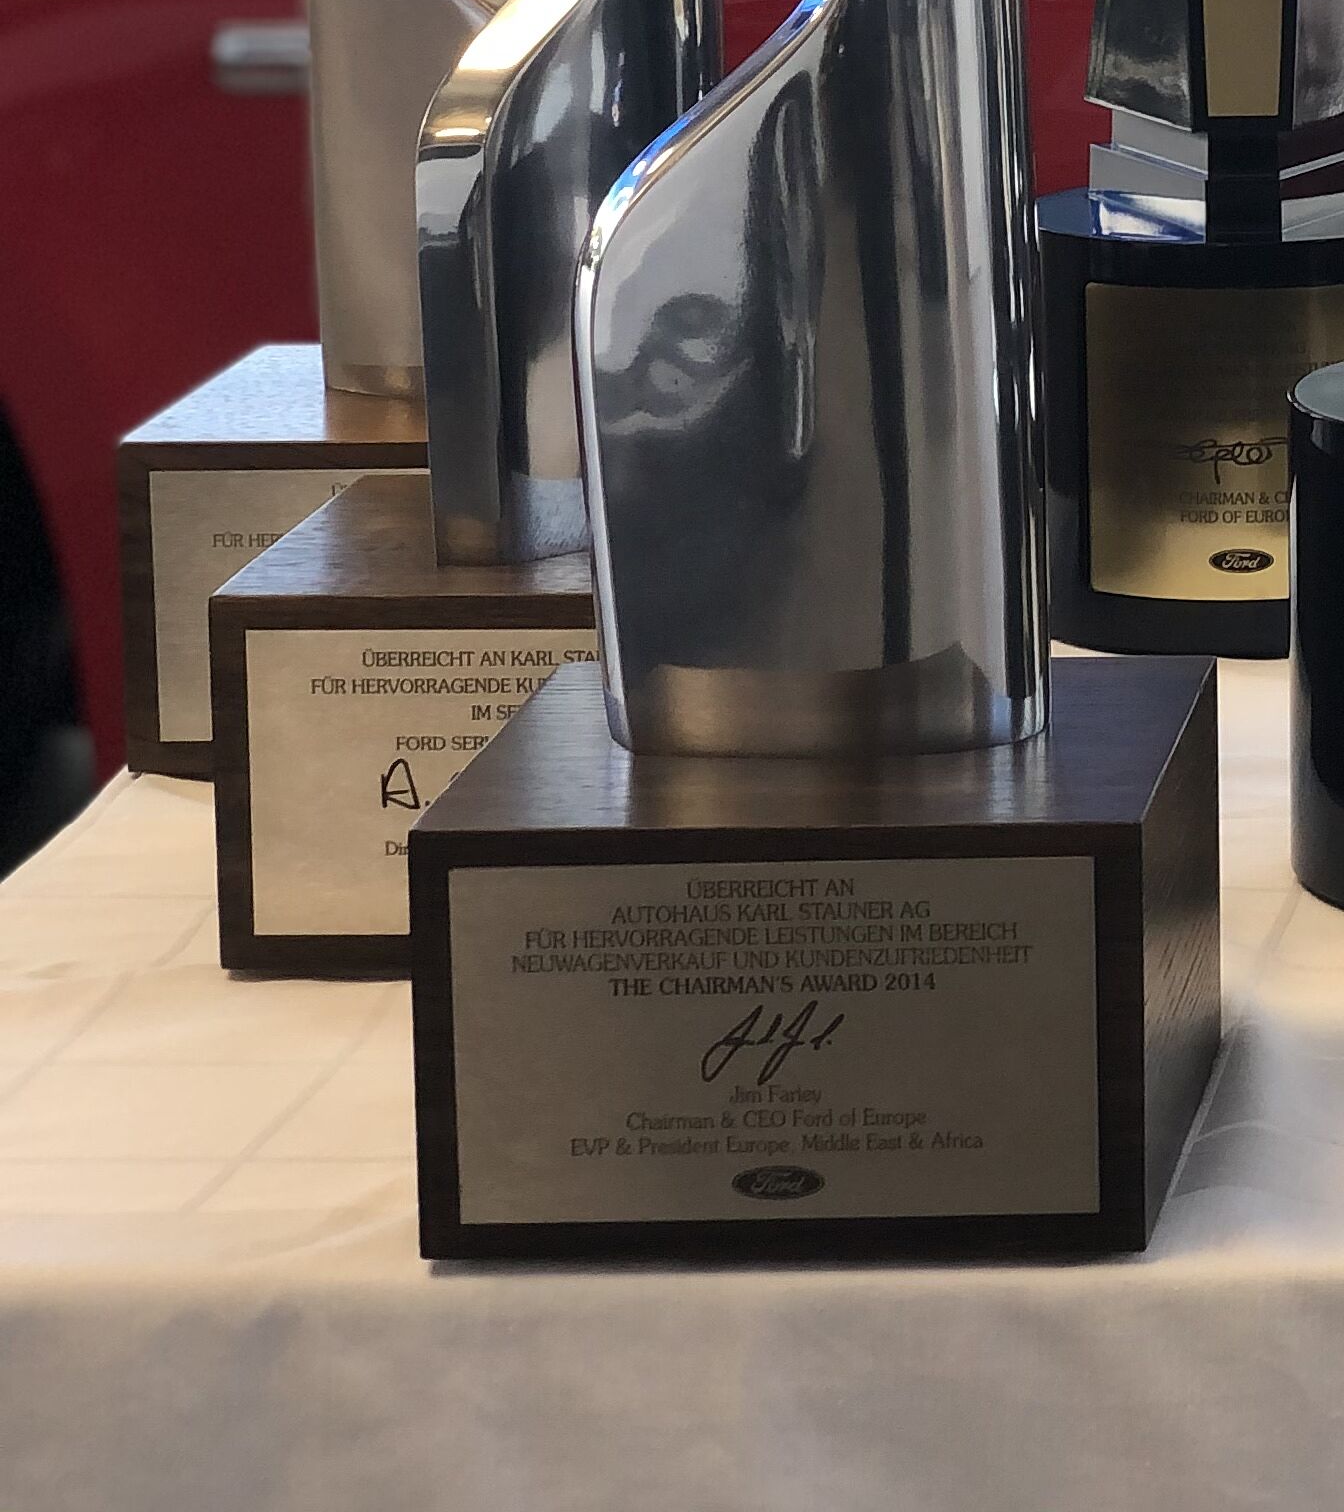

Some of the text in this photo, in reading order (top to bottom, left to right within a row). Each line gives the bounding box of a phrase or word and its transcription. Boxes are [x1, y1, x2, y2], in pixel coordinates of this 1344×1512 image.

[1179, 491, 1255, 505] CHAIRMAN
[1258, 491, 1269, 505] &
[1180, 510, 1218, 523] FORD
[1222, 510, 1243, 524] OF
[213, 531, 245, 548] FÜR
[362, 649, 475, 668] ÜBERREICHT
[480, 650, 506, 667] AN
[510, 650, 559, 667] KARL
[311, 676, 346, 695] FÜR
[351, 678, 512, 695] HERVORRAGENDE
[471, 704, 491, 721] IM
[396, 736, 446, 751] FORD
[687, 877, 855, 899] ÜBERREICHT AN
[611, 900, 931, 925] AUTOHAUS KARL STAUNER AG
[525, 921, 1017, 950] FÜR HERVORRAGENDE LEISTUNGEN IM BEREICH
[511, 945, 1034, 974] NEUWAGENVERKAUF UND KUNDENZUFRIEDENHEIT
[609, 972, 936, 997] THE CHAIRMAN'S AWARD 2014
[729, 1084, 762, 1104] Jim
[626, 1107, 927, 1131] Chairman & CEO Ford of Europe
[570, 1137, 610, 1156] EVP
[615, 1137, 632, 1156] &
[638, 1136, 720, 1155] President
[801, 1133, 860, 1152] Middle
[866, 1133, 902, 1151] East
[908, 1132, 924, 1150] &
[931, 1131, 984, 1149] Africa
